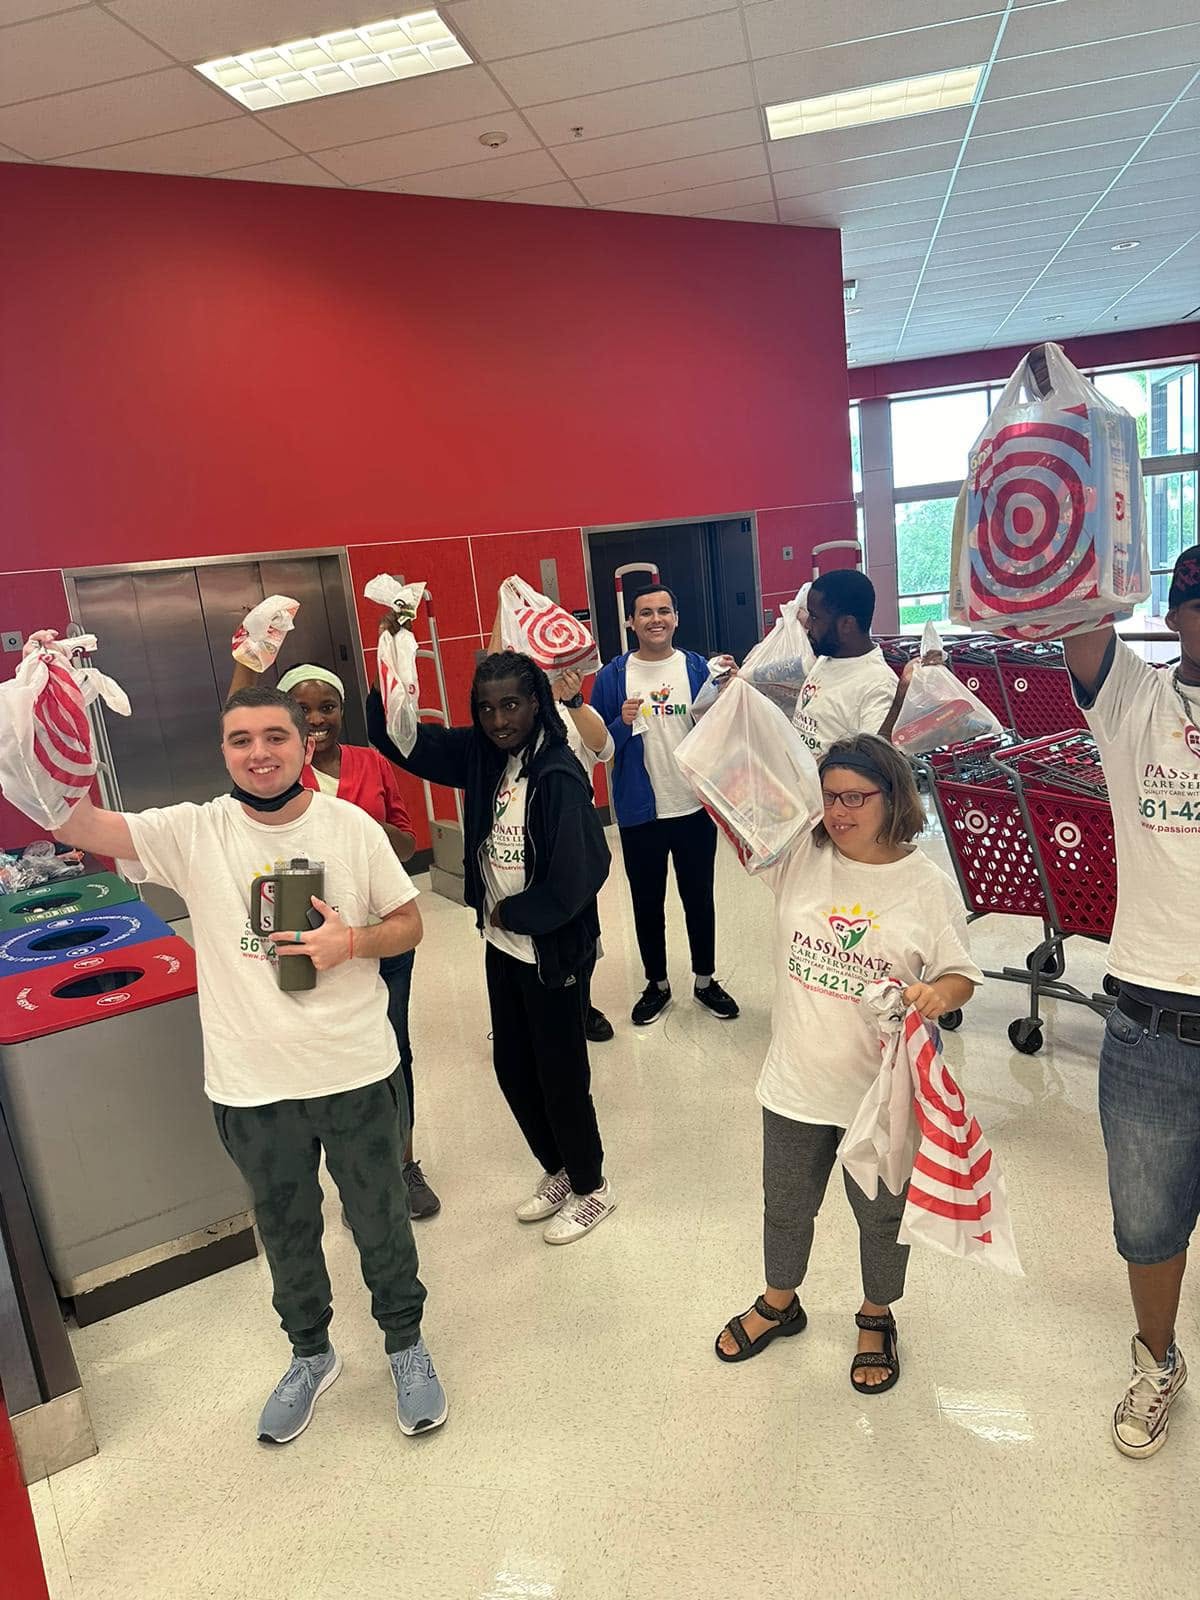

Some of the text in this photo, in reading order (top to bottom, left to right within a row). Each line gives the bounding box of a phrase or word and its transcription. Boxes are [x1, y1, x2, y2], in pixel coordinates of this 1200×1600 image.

[641, 702, 687, 718] UTISM
[1144, 763, 1200, 780] PASSI
[1143, 779, 1176, 789] CARE
[1169, 789, 1186, 797] CARE
[1186, 790, 1200, 798] WIT
[1138, 796, 1200, 821] 61-42
[790, 944, 819, 961] CARE
[820, 956, 870, 978] SERVICES
[792, 930, 893, 972] PASSIONATE
[788, 957, 866, 997] 561-421-2
